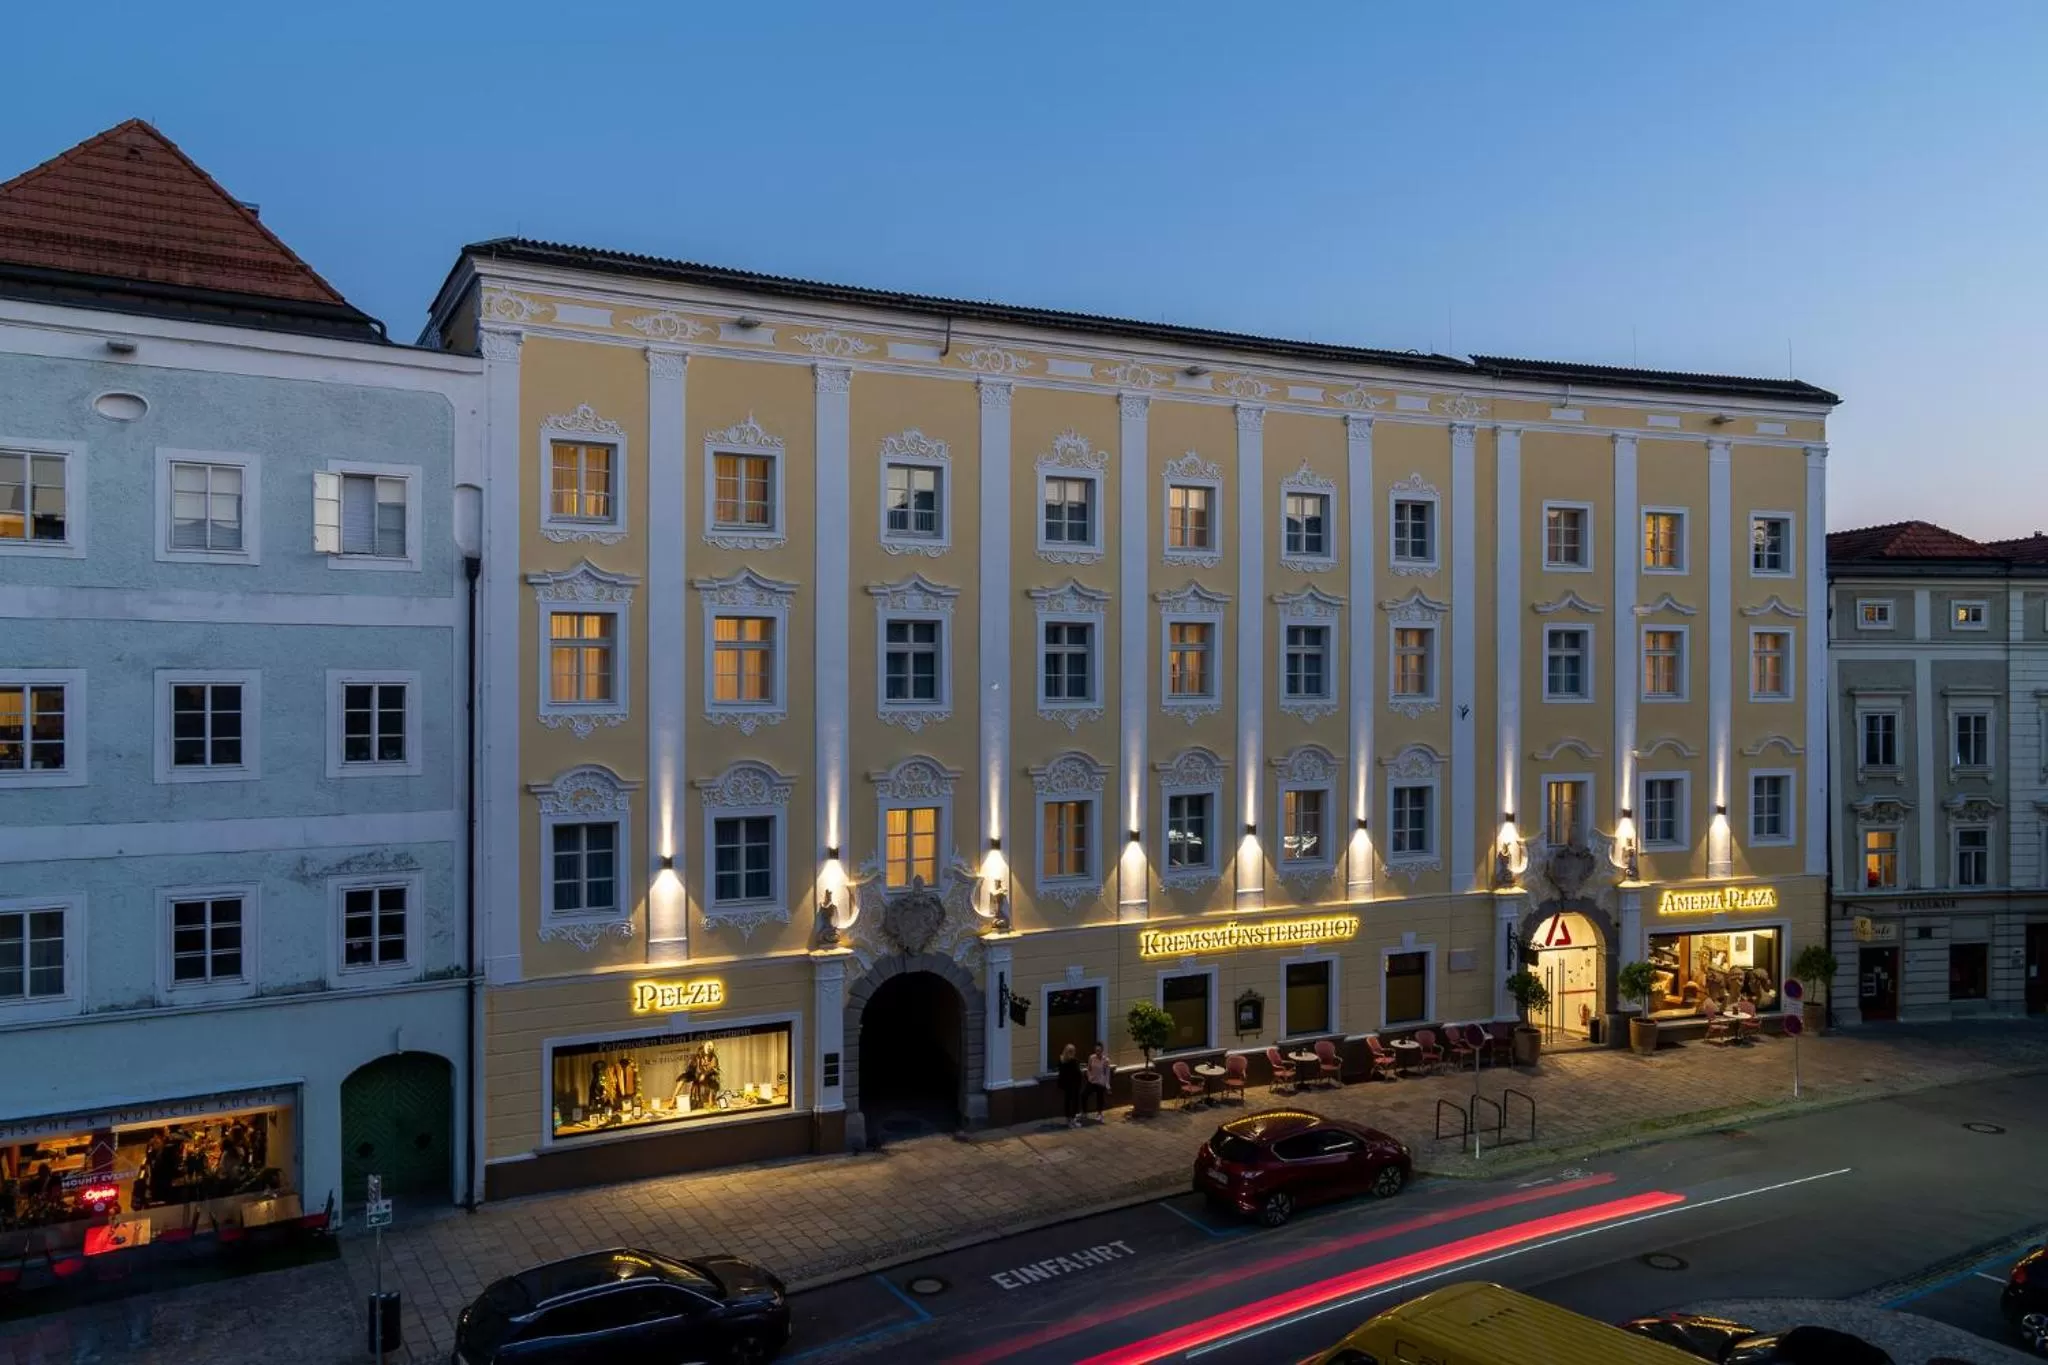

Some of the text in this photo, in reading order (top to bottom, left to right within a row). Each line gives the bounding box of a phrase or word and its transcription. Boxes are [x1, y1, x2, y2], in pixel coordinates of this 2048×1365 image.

[1663, 889, 1776, 912] AMEDIA PLAZA
[1142, 917, 1359, 955] KREMSMÜNSTERERHOF
[636, 982, 721, 1010] PELZE
[62, 1176, 99, 1190] MOUNT
[84, 1188, 117, 1201] Open
[990, 1240, 1136, 1290] EINFAHRT
